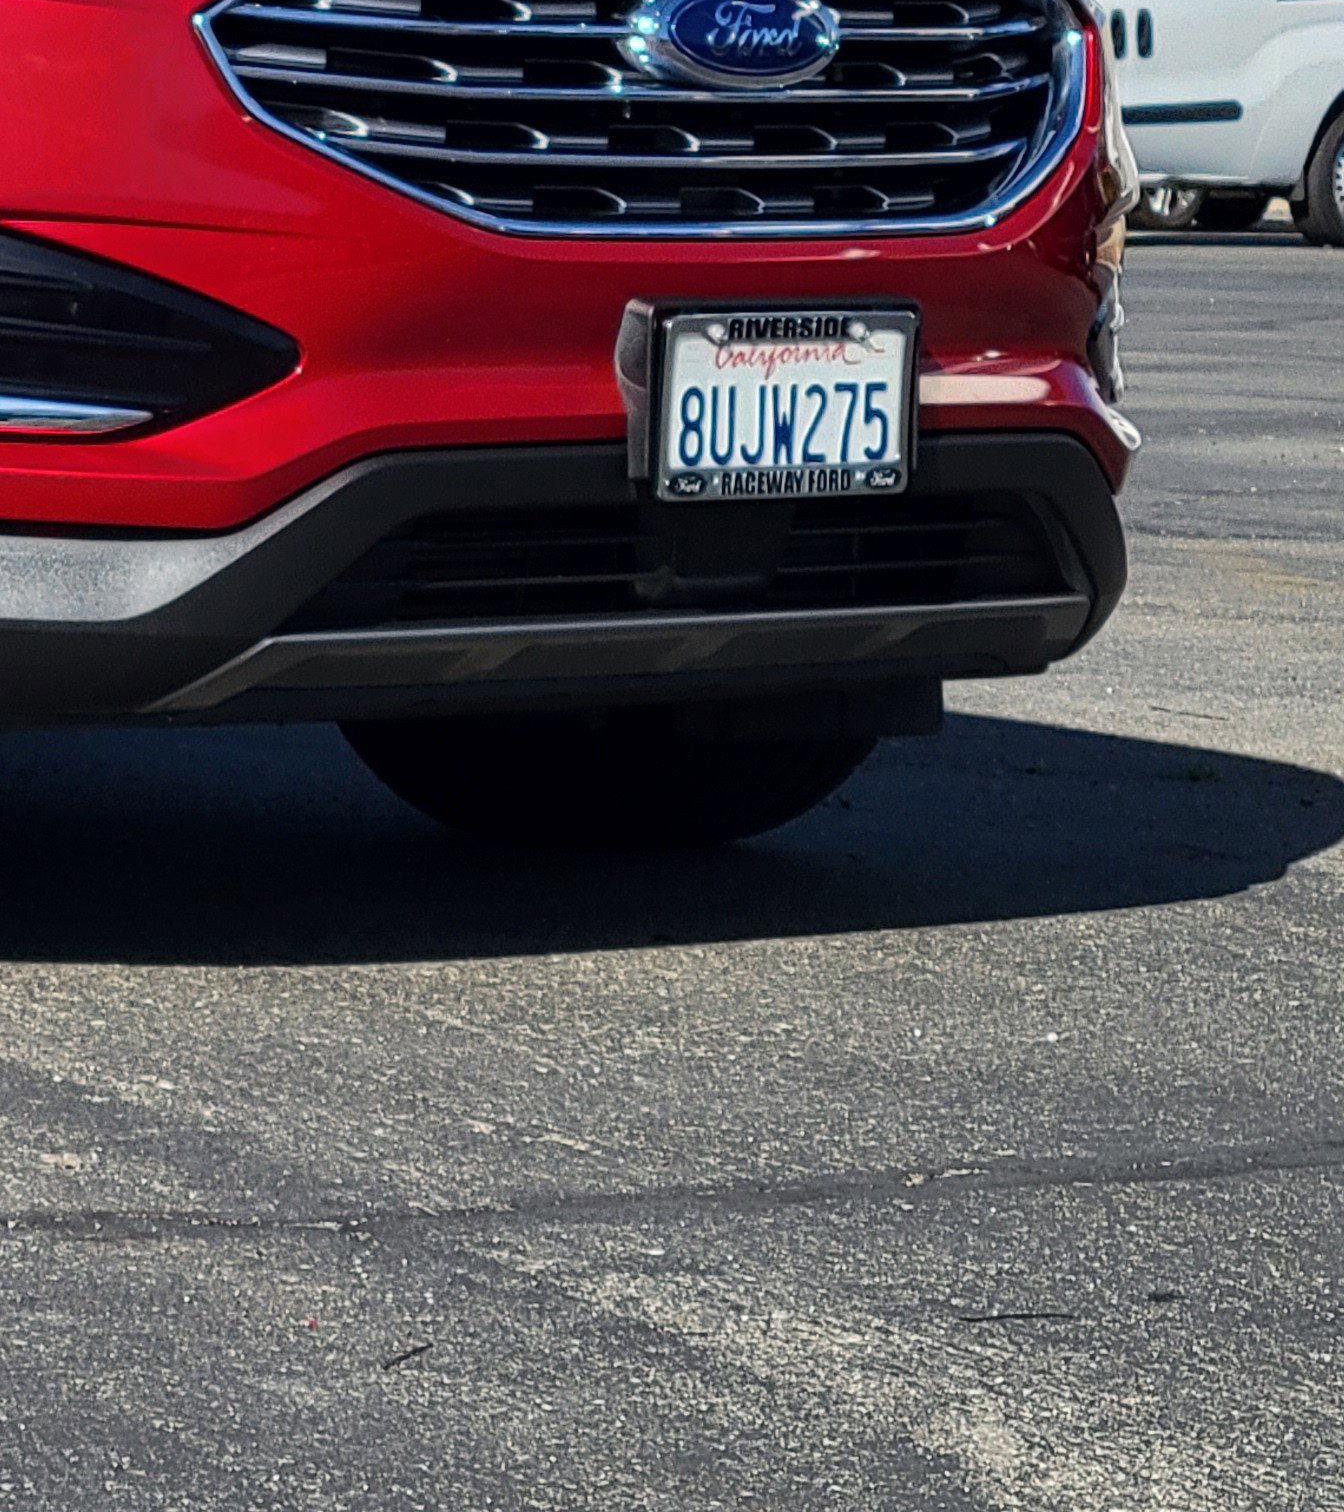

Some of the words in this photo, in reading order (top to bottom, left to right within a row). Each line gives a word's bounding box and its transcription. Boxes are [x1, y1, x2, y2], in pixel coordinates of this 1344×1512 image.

[706, 0, 805, 58] Ford
[716, 341, 861, 380] California
[678, 382, 889, 466] 8UJW275
[720, 470, 803, 495] RACEWAY
[809, 469, 852, 492] FORD
